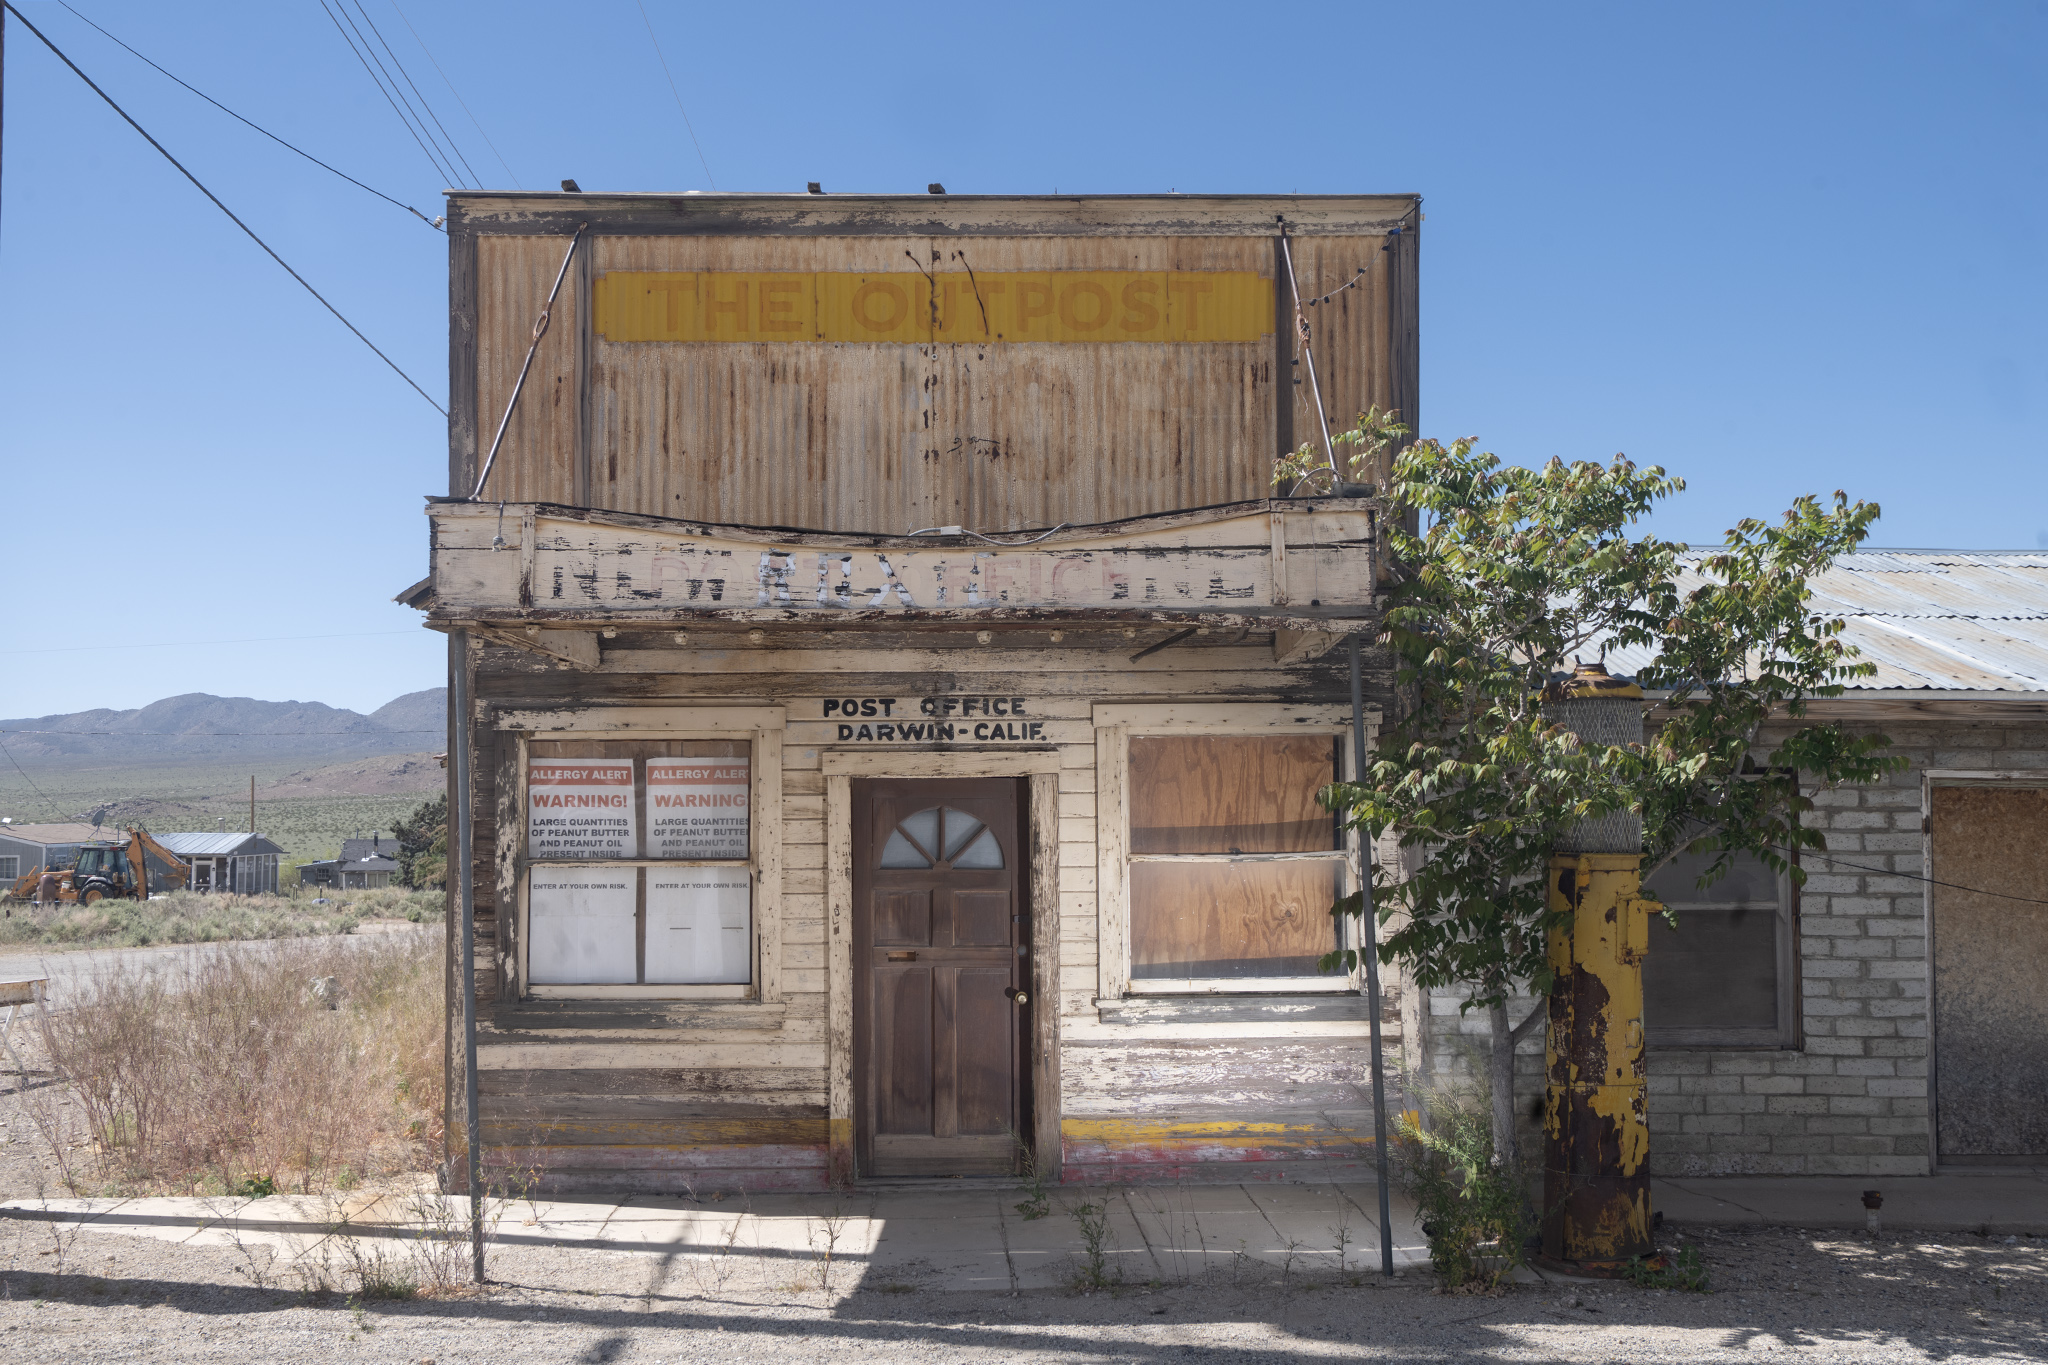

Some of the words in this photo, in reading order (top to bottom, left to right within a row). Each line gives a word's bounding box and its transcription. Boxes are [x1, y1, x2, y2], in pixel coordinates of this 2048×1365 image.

[647, 279, 801, 332] THE
[851, 280, 1215, 333] OUTPOST
[823, 698, 897, 717] POST
[920, 697, 1027, 716] OFFICE
[531, 770, 588, 780] ALLERGY
[592, 770, 628, 780] ALERT
[652, 769, 711, 779] ALLERGY
[533, 794, 628, 808] WARNING!
[533, 818, 567, 827] LARGE
[569, 818, 628, 828] QUANTITIES
[655, 818, 689, 826] LARGE
[531, 829, 546, 838] OF
[548, 829, 589, 838] PEANUT
[591, 829, 630, 837] BUTTER
[653, 828, 667, 837] OF
[670, 828, 711, 837] PEANUT
[539, 839, 561, 848] AND
[563, 839, 603, 848] PEANUT
[606, 839, 623, 848] OIL
[661, 839, 683, 847] AND
[685, 839, 726, 847] PEANUT
[728, 839, 745, 847] OIL
[539, 850, 586, 858] PRESENT
[588, 850, 622, 858] INSIDE
[662, 850, 708, 858] PRESENT
